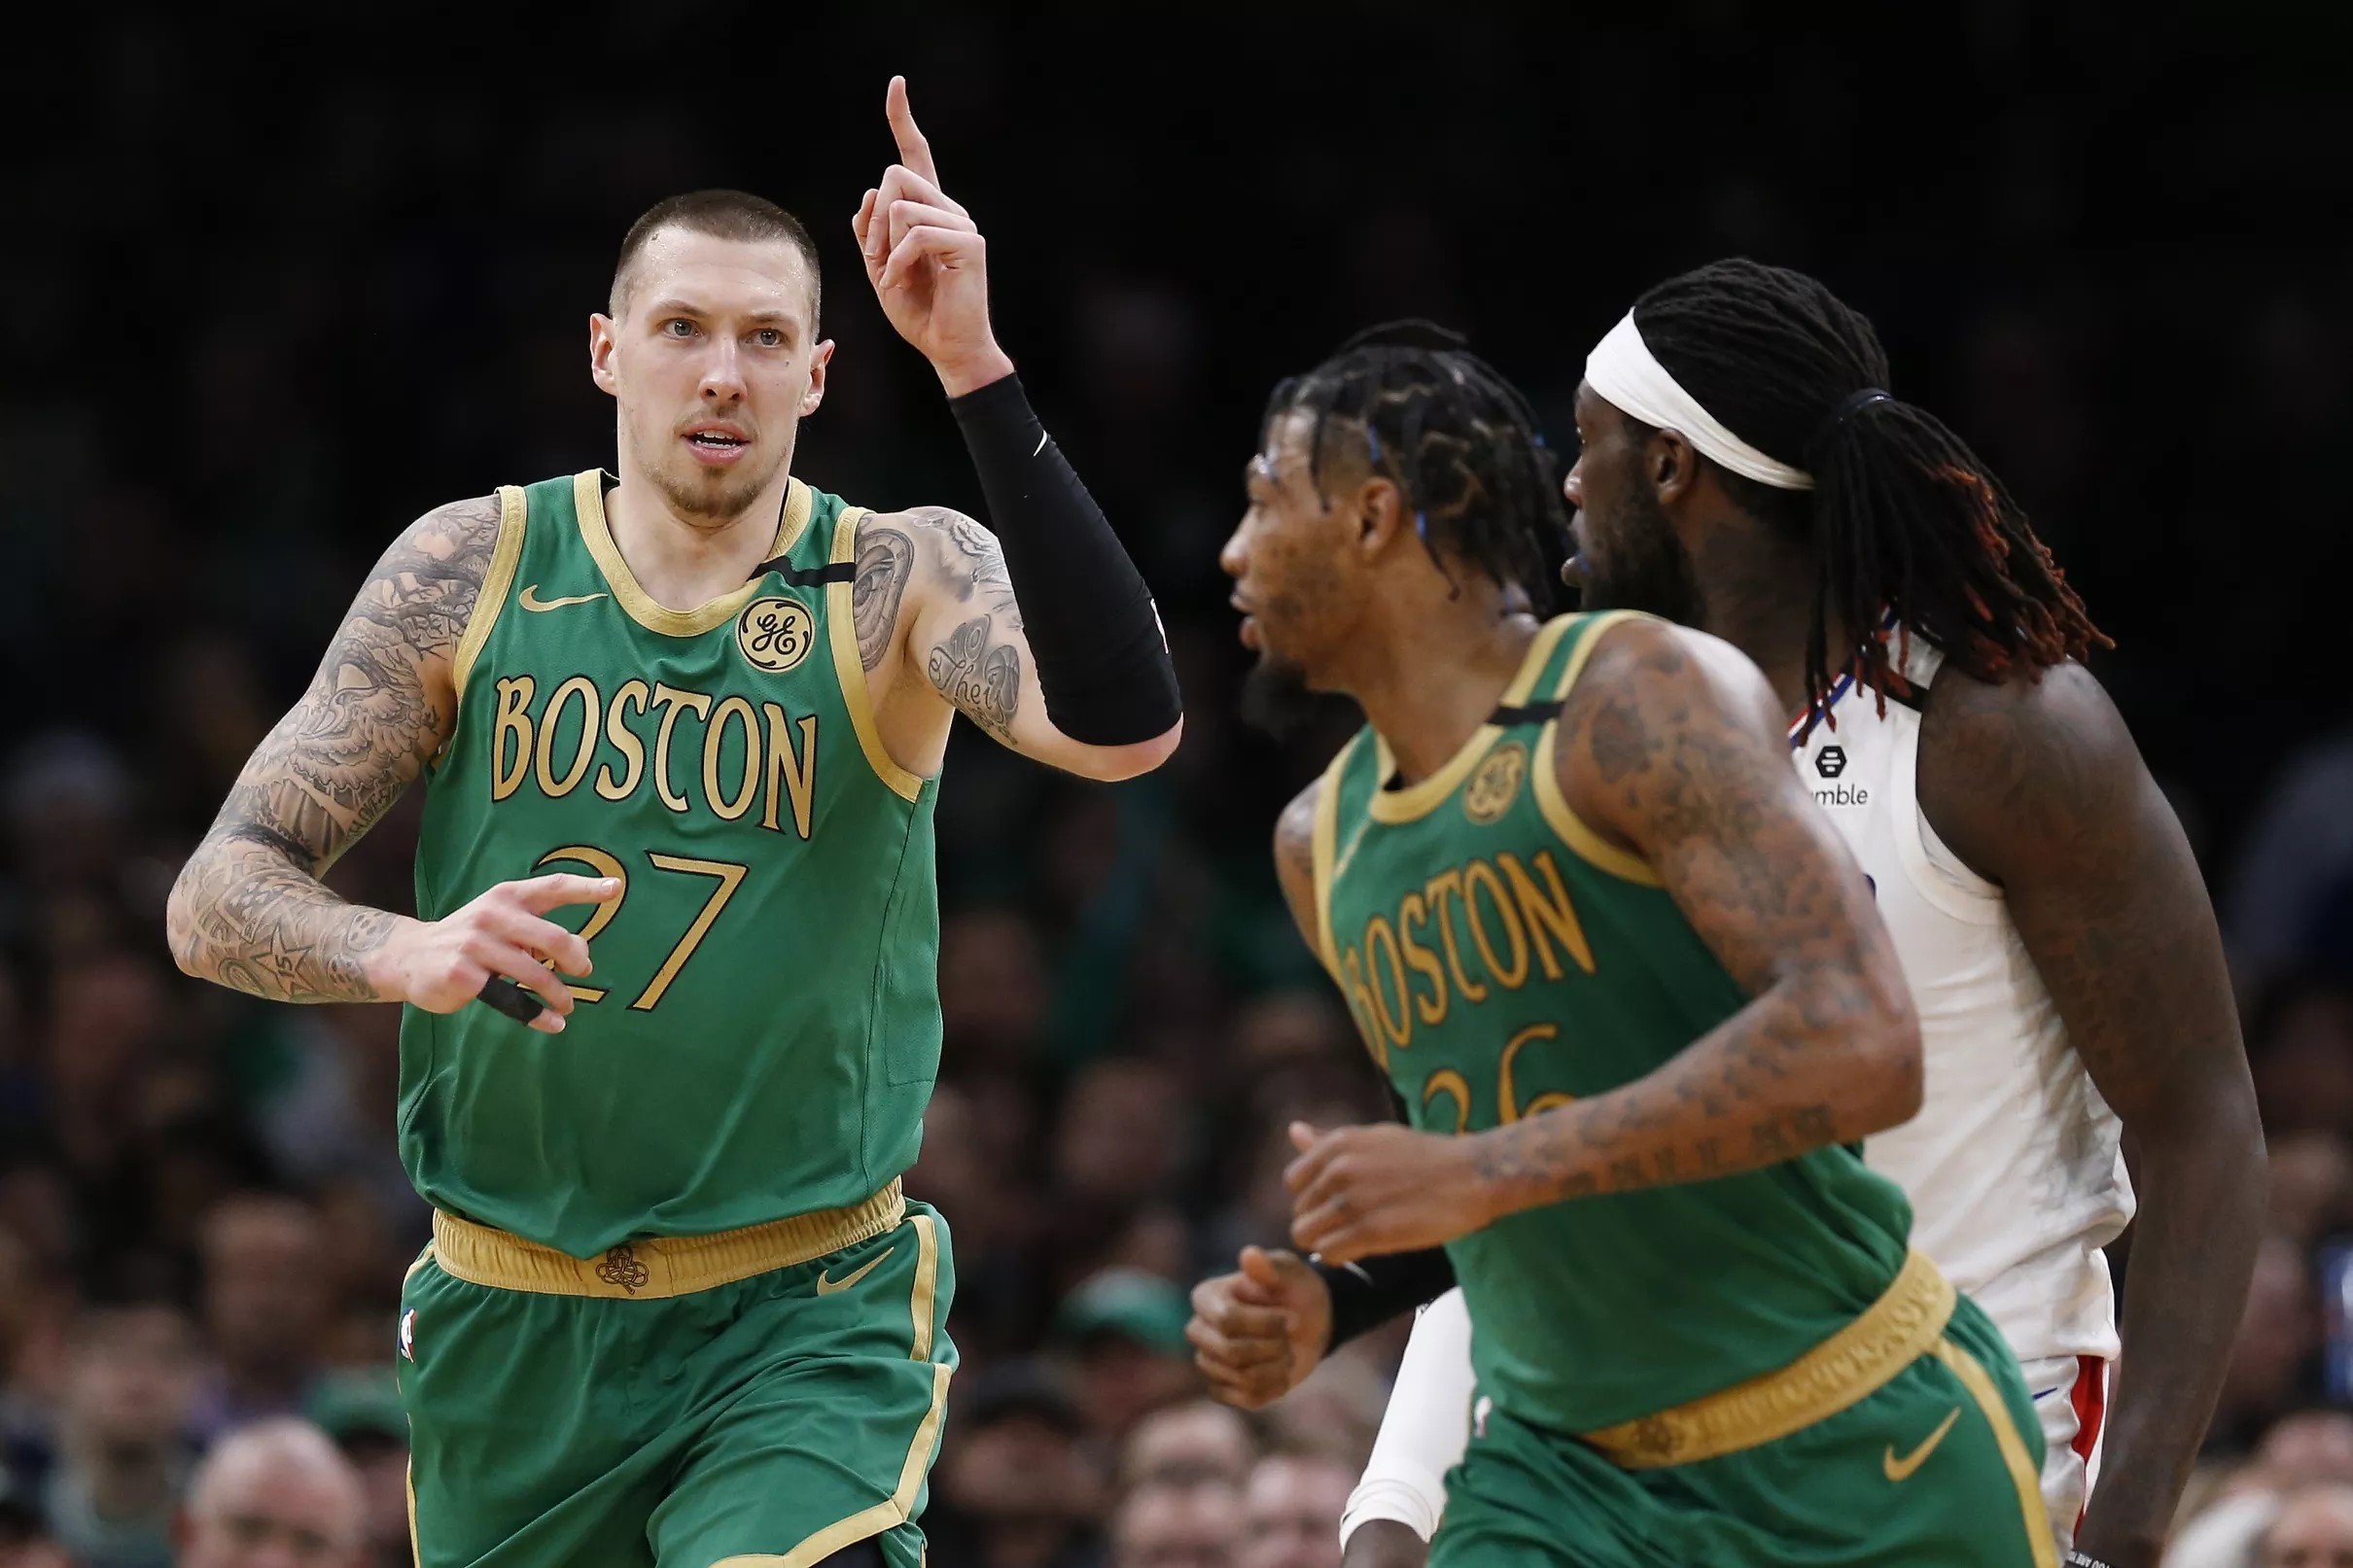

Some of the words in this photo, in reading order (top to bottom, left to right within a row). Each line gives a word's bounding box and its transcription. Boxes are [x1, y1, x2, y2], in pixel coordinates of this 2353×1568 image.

[492, 675, 819, 840] BOSTON
[1811, 784, 1868, 805] mble
[516, 844, 749, 1011] 27
